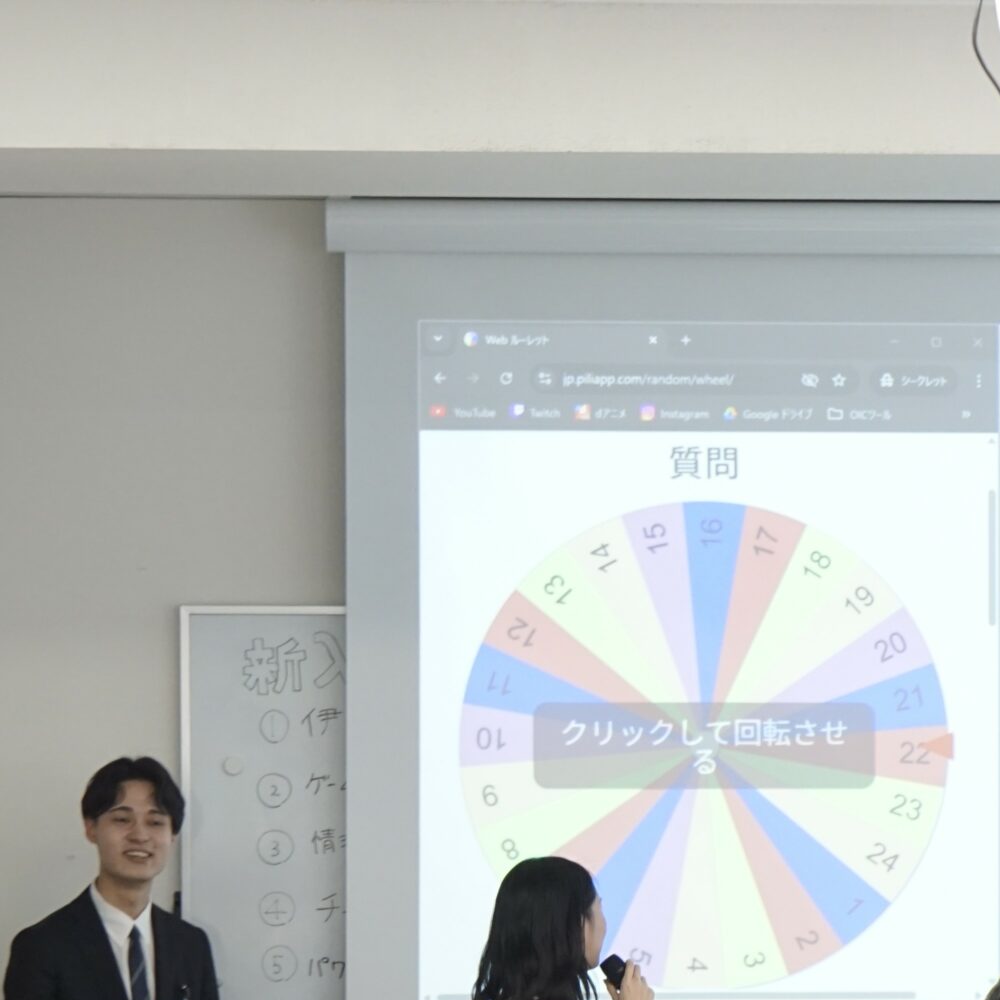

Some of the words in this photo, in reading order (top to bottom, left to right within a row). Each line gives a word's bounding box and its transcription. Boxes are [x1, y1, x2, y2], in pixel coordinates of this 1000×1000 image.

[484, 334, 509, 346] Web
[510, 334, 550, 347] ルーレット
[562, 371, 735, 389] jp.piliapp.com/random/wheel/
[901, 374, 948, 388] シークレット
[454, 406, 496, 419] YouTube
[528, 407, 561, 419] Twitch
[660, 408, 710, 422] Instagram
[742, 409, 779, 422] Google
[781, 409, 814, 420] ドライブ
[669, 445, 739, 480] 質問
[643, 523, 668, 554] 15
[700, 518, 723, 546] 16
[753, 526, 779, 557] 17
[590, 542, 619, 571] 14
[803, 550, 831, 580] 18
[544, 574, 574, 604] 13
[844, 586, 875, 615] 19
[507, 618, 536, 647] 12
[873, 632, 907, 662] 20
[487, 672, 512, 695] 11
[893, 684, 924, 712] 21
[477, 727, 506, 750] 10
[561, 718, 847, 748] クリックして回転させ
[692, 750, 717, 774] る
[899, 741, 930, 764] 22
[889, 794, 923, 821] 23
[501, 840, 519, 859] 8
[866, 843, 899, 872] 24
[315, 893, 346, 923] チ
[841, 898, 862, 915] 1
[795, 930, 820, 950] 2
[630, 948, 652, 966] 5
[687, 958, 709, 973] 4
[743, 952, 766, 967] 3
